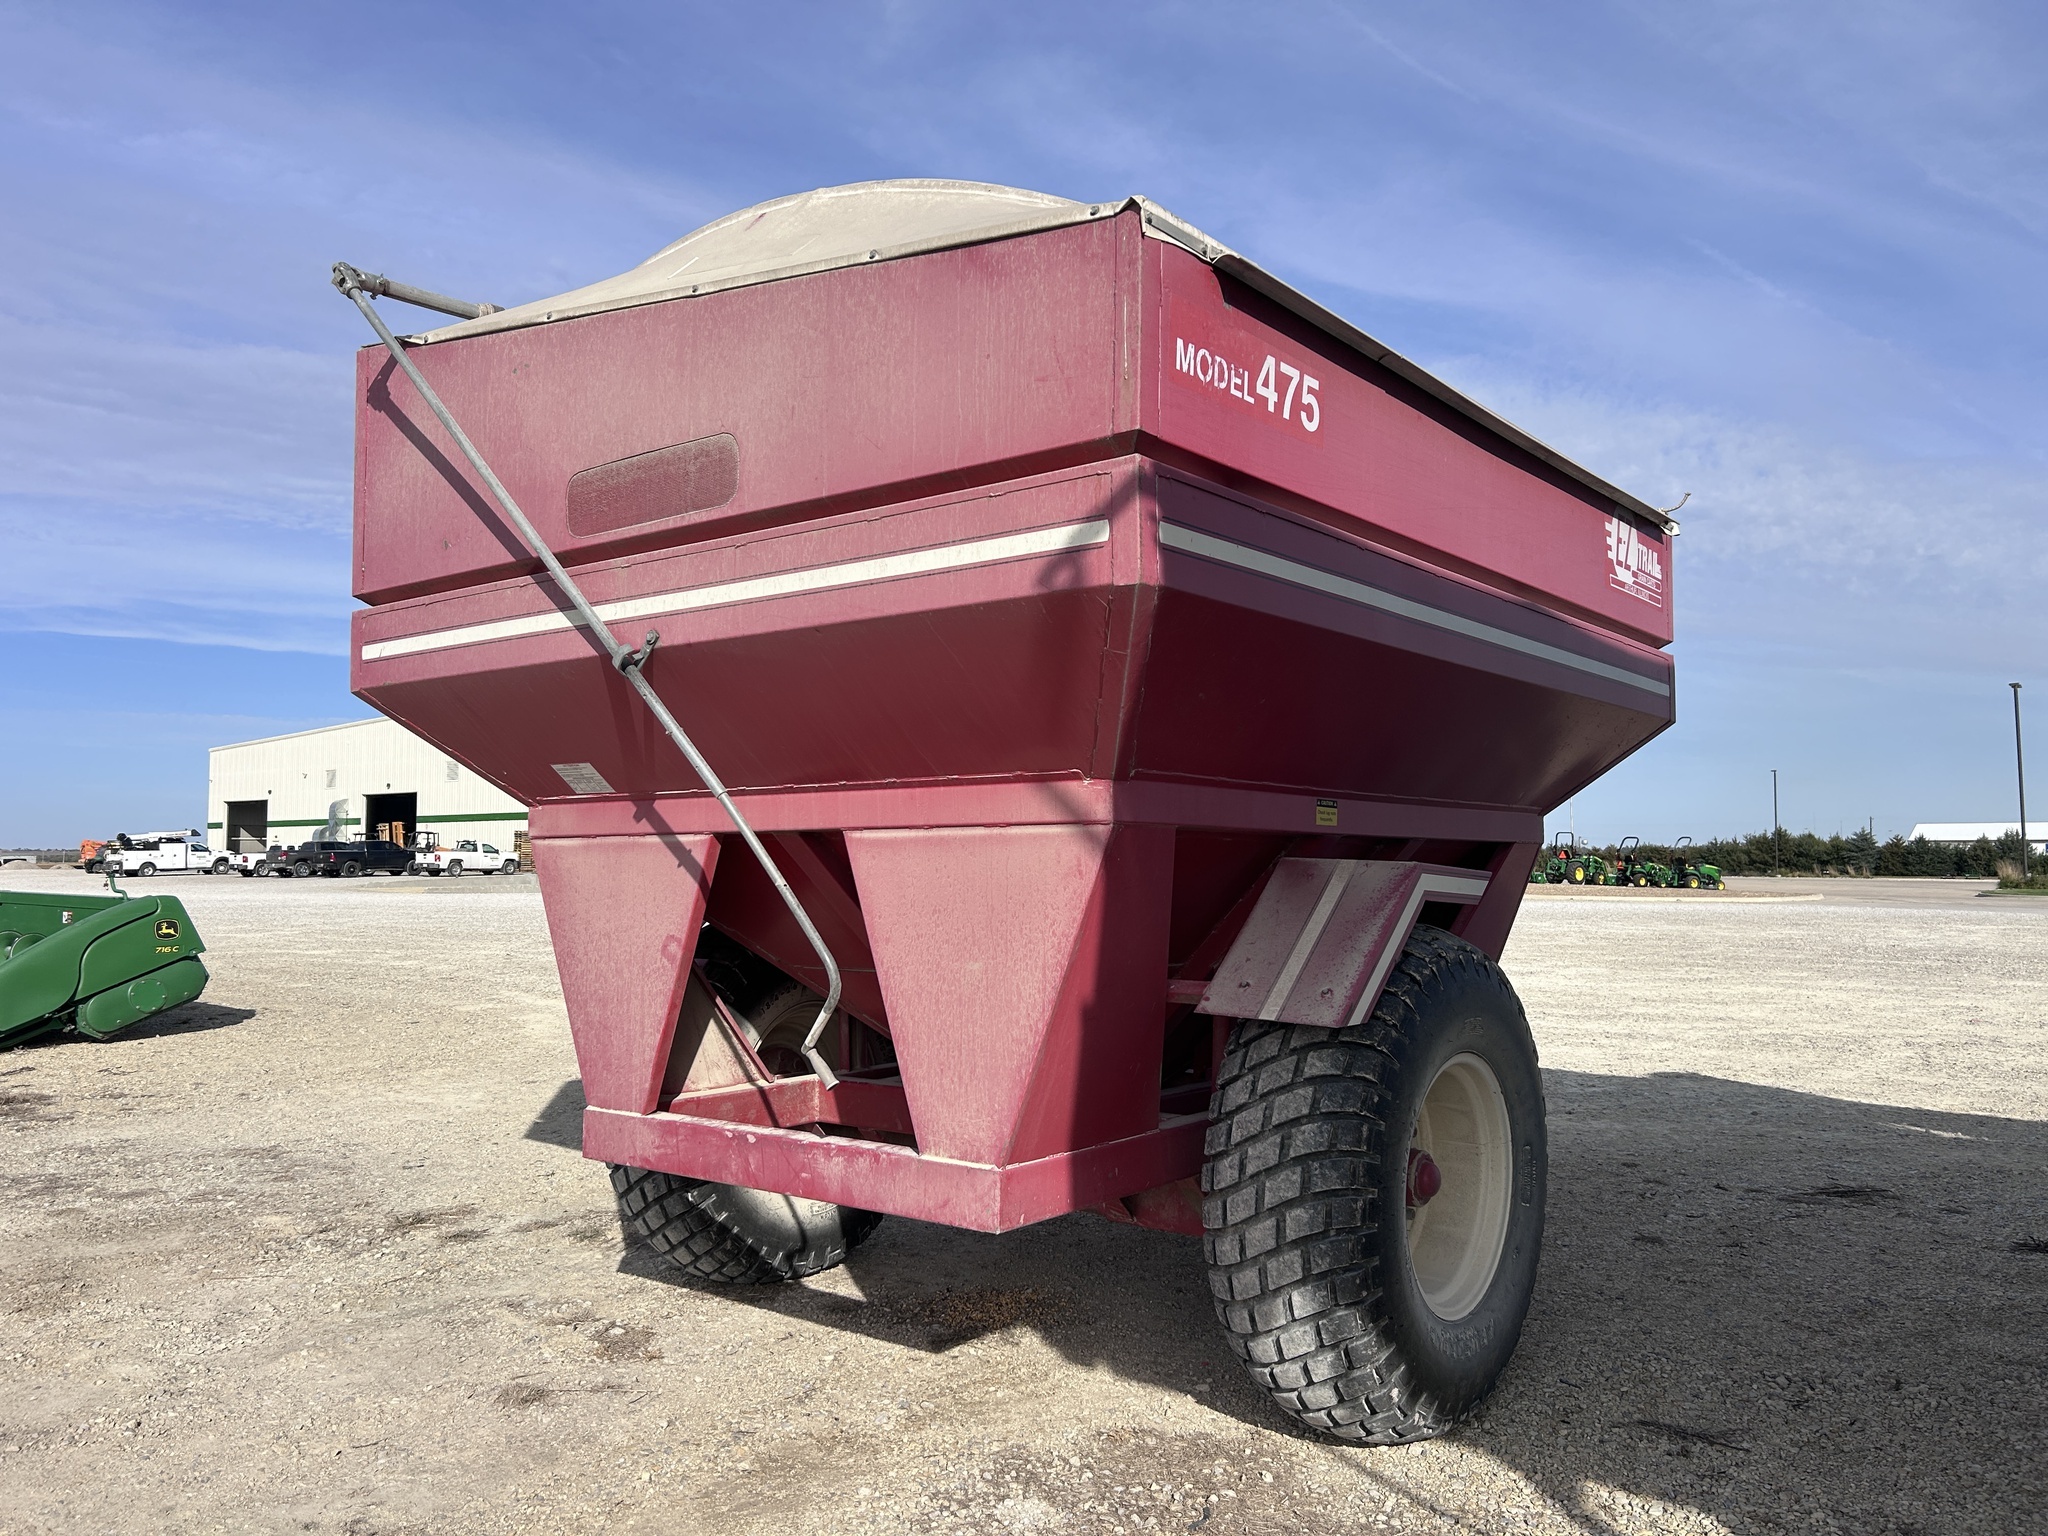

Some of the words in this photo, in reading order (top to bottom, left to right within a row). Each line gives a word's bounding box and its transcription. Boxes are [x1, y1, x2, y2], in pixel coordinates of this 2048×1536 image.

[1175, 337, 1255, 405] MODEL
[1256, 354, 1320, 432] 475
[155, 946, 172, 954] 716
